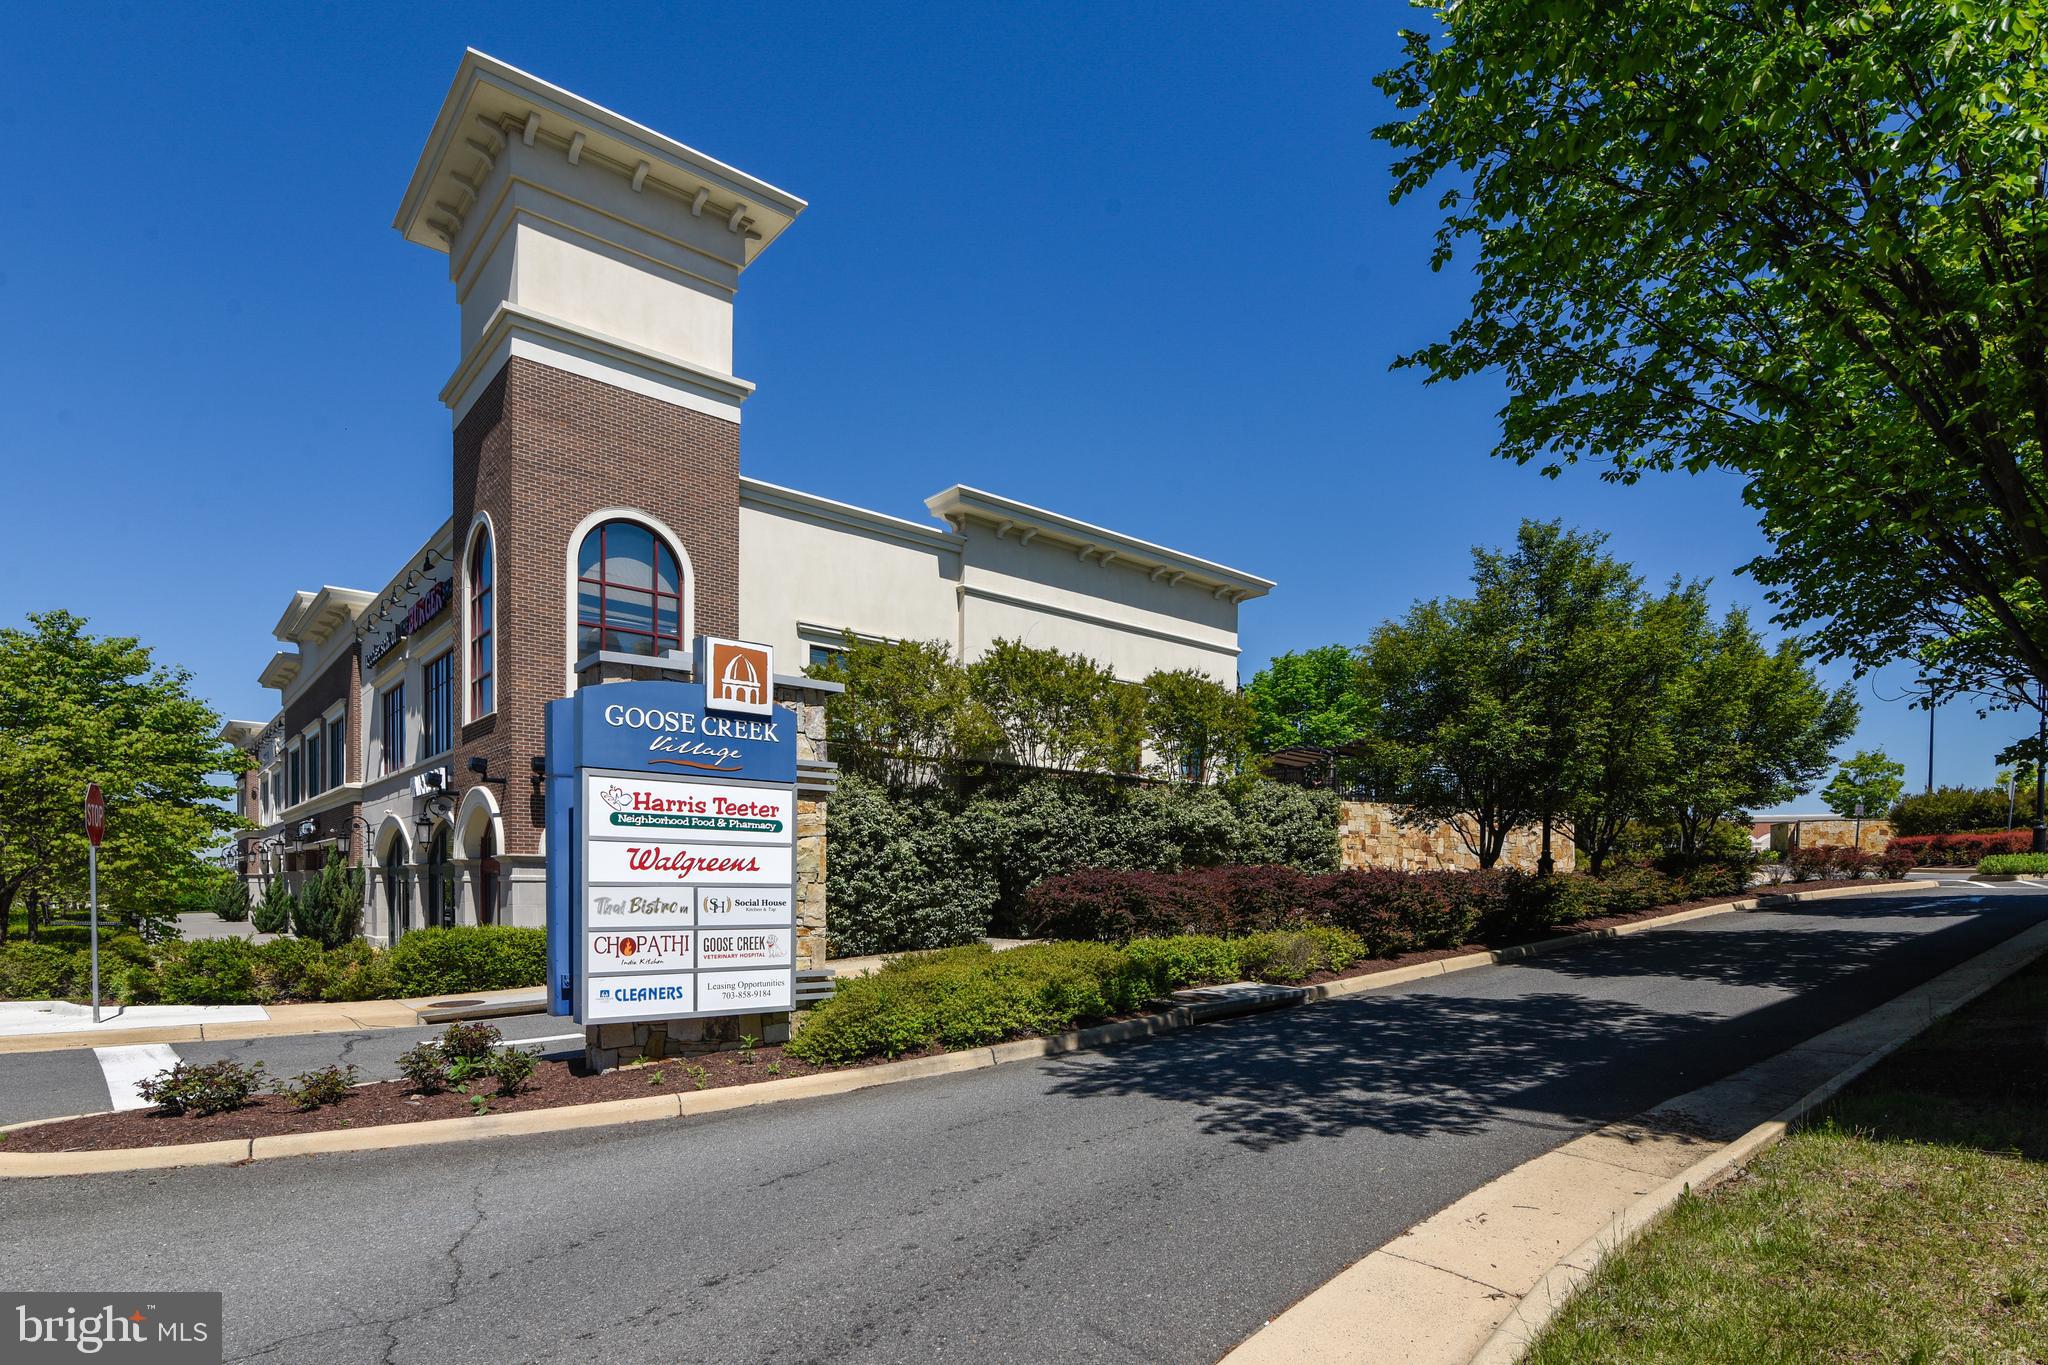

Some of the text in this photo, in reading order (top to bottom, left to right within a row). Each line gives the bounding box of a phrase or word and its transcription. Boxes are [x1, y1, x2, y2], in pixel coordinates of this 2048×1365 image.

[604, 704, 779, 743] GOOSE CREEK
[649, 735, 742, 766] Village
[632, 791, 780, 818] Harris Teeter
[87, 803, 104, 828] STOP
[617, 814, 777, 832] Neighborhood Food & Pharmacy
[626, 846, 760, 880] Walgreens
[593, 896, 626, 915] Thai
[629, 896, 679, 915] Bistro
[734, 899, 787, 907] Social House
[593, 934, 690, 958] CHOPATHI
[703, 935, 766, 953] GOOSE CREEK
[614, 986, 683, 1002] CLEANERS
[707, 979, 785, 991] Leasing Opportunities
[721, 989, 771, 1000] 703-858-9184
